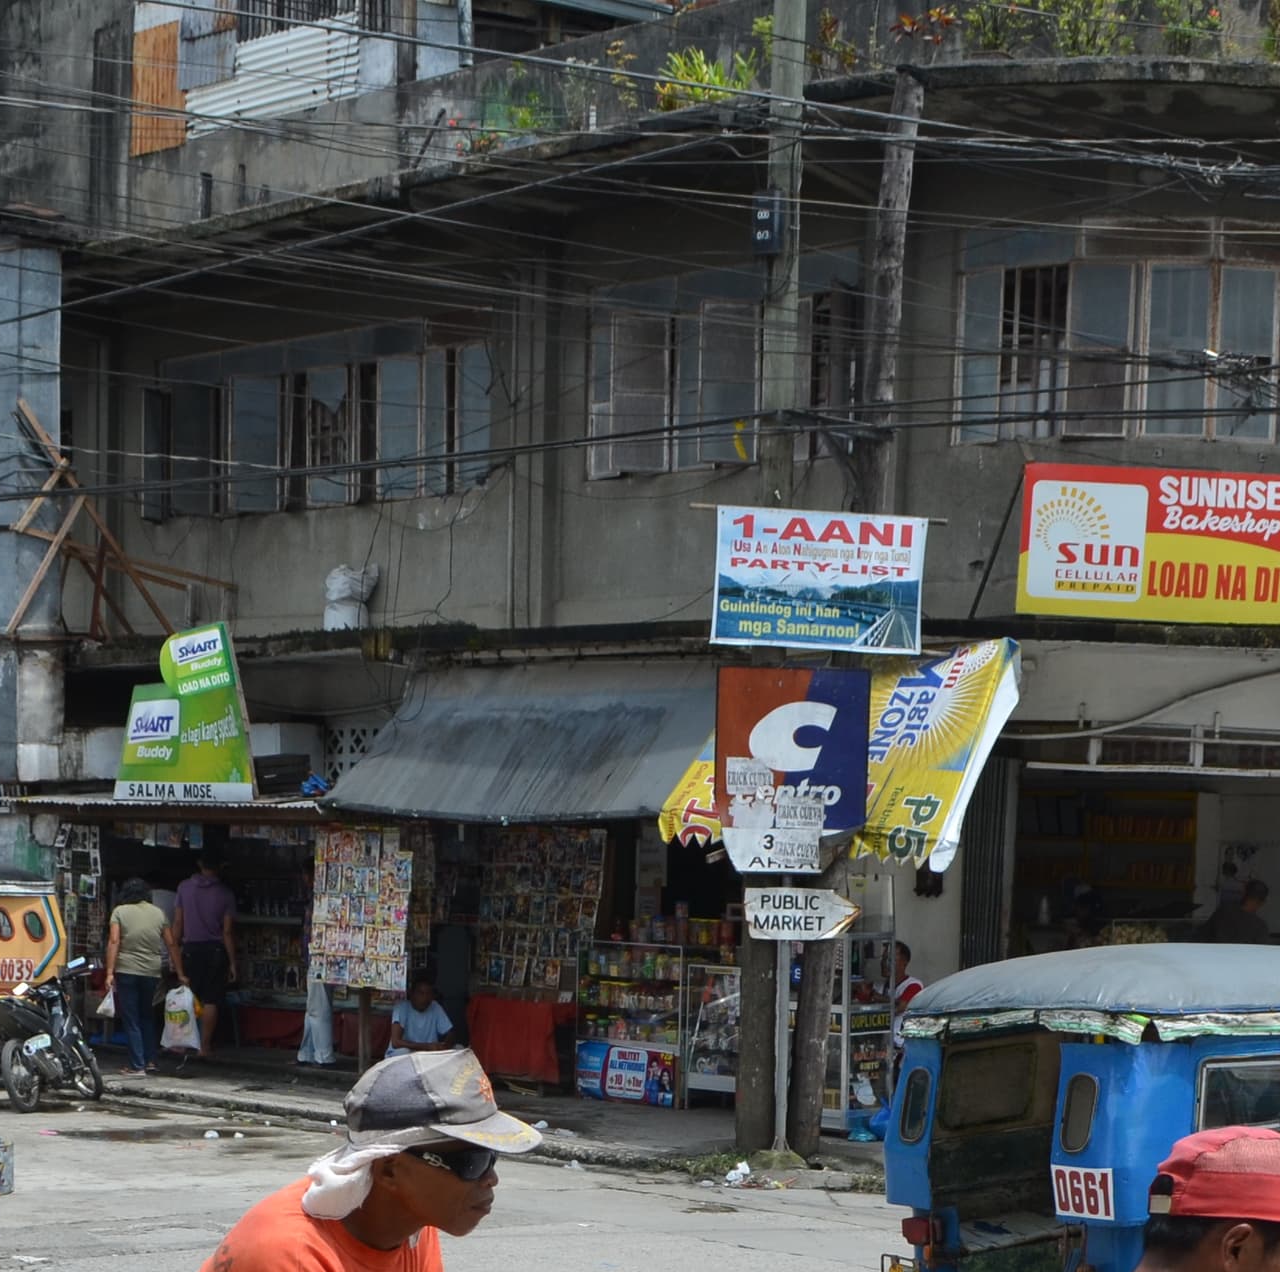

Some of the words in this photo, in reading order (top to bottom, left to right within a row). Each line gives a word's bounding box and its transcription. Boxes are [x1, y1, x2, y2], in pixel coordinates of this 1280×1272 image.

[732, 513, 914, 549] 1-AANI
[1055, 541, 1140, 568] sun
[730, 556, 911, 578] PARTY-LIST
[1055, 568, 1139, 583] CELLULAR
[1055, 581, 1136, 594] PREPAID
[1146, 560, 1210, 600] LOAD
[1214, 563, 1248, 602] NA
[719, 598, 793, 619] Guintindog
[815, 603, 841, 619] han
[738, 619, 773, 638] mga
[776, 618, 861, 639] Samarnon!
[177, 638, 219, 659] SMART
[190, 656, 223, 672] Buddy
[177, 679, 200, 695] LOAD
[199, 677, 211, 690] NA
[211, 671, 231, 687] DITO
[131, 714, 175, 735] SMART
[136, 744, 174, 761] Buddy
[128, 782, 176, 799] SALMA
[183, 782, 217, 800] MDSE.
[760, 894, 820, 911] PUBLIC
[753, 915, 826, 932] MARKET
[0, 958, 34, 981] 0039
[1055, 1166, 1113, 1221] 0661
